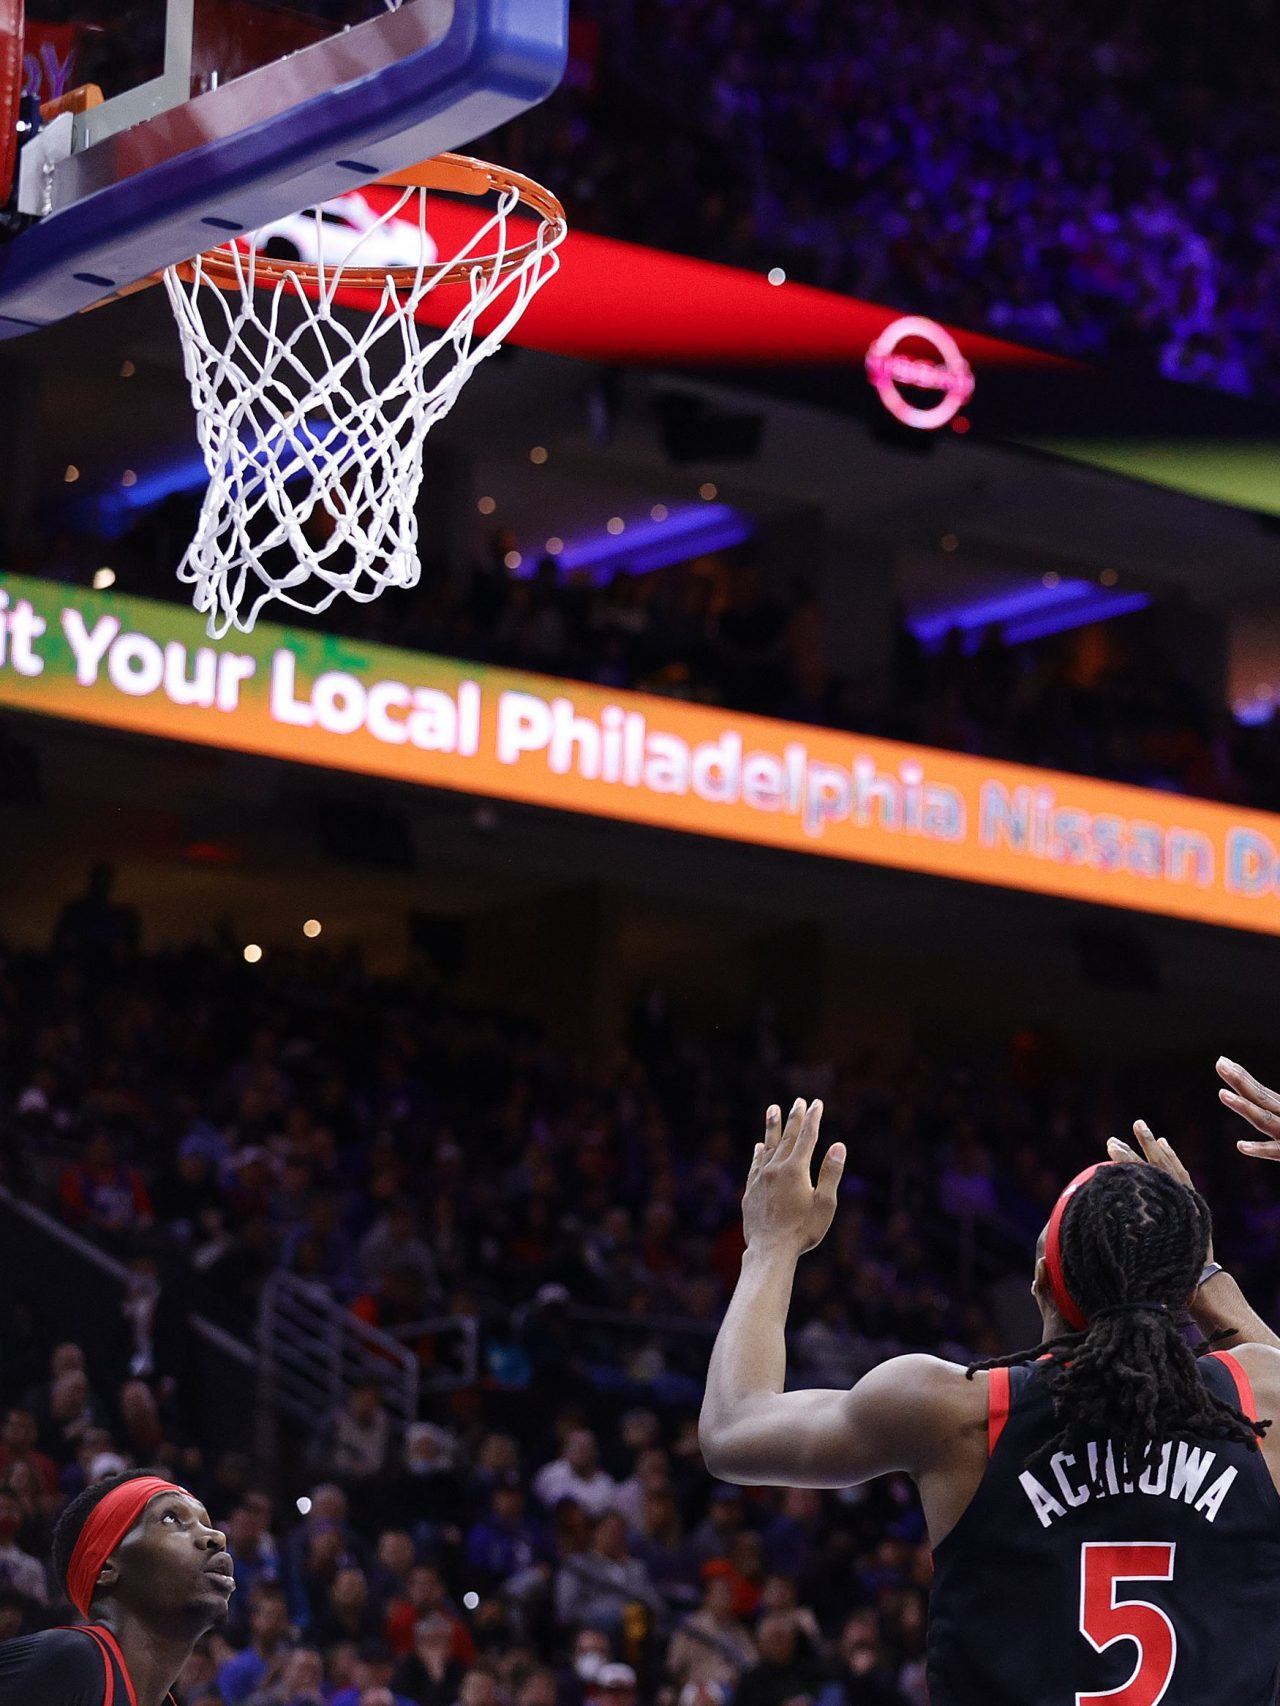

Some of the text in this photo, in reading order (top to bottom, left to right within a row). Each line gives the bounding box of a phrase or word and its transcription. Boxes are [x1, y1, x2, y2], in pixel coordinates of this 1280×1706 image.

[61, 607, 256, 713] Your
[270, 648, 481, 758] Local
[497, 689, 966, 844] Philadelphia
[979, 778, 1216, 890] Nissan
[1075, 1541, 1176, 1706] 5
